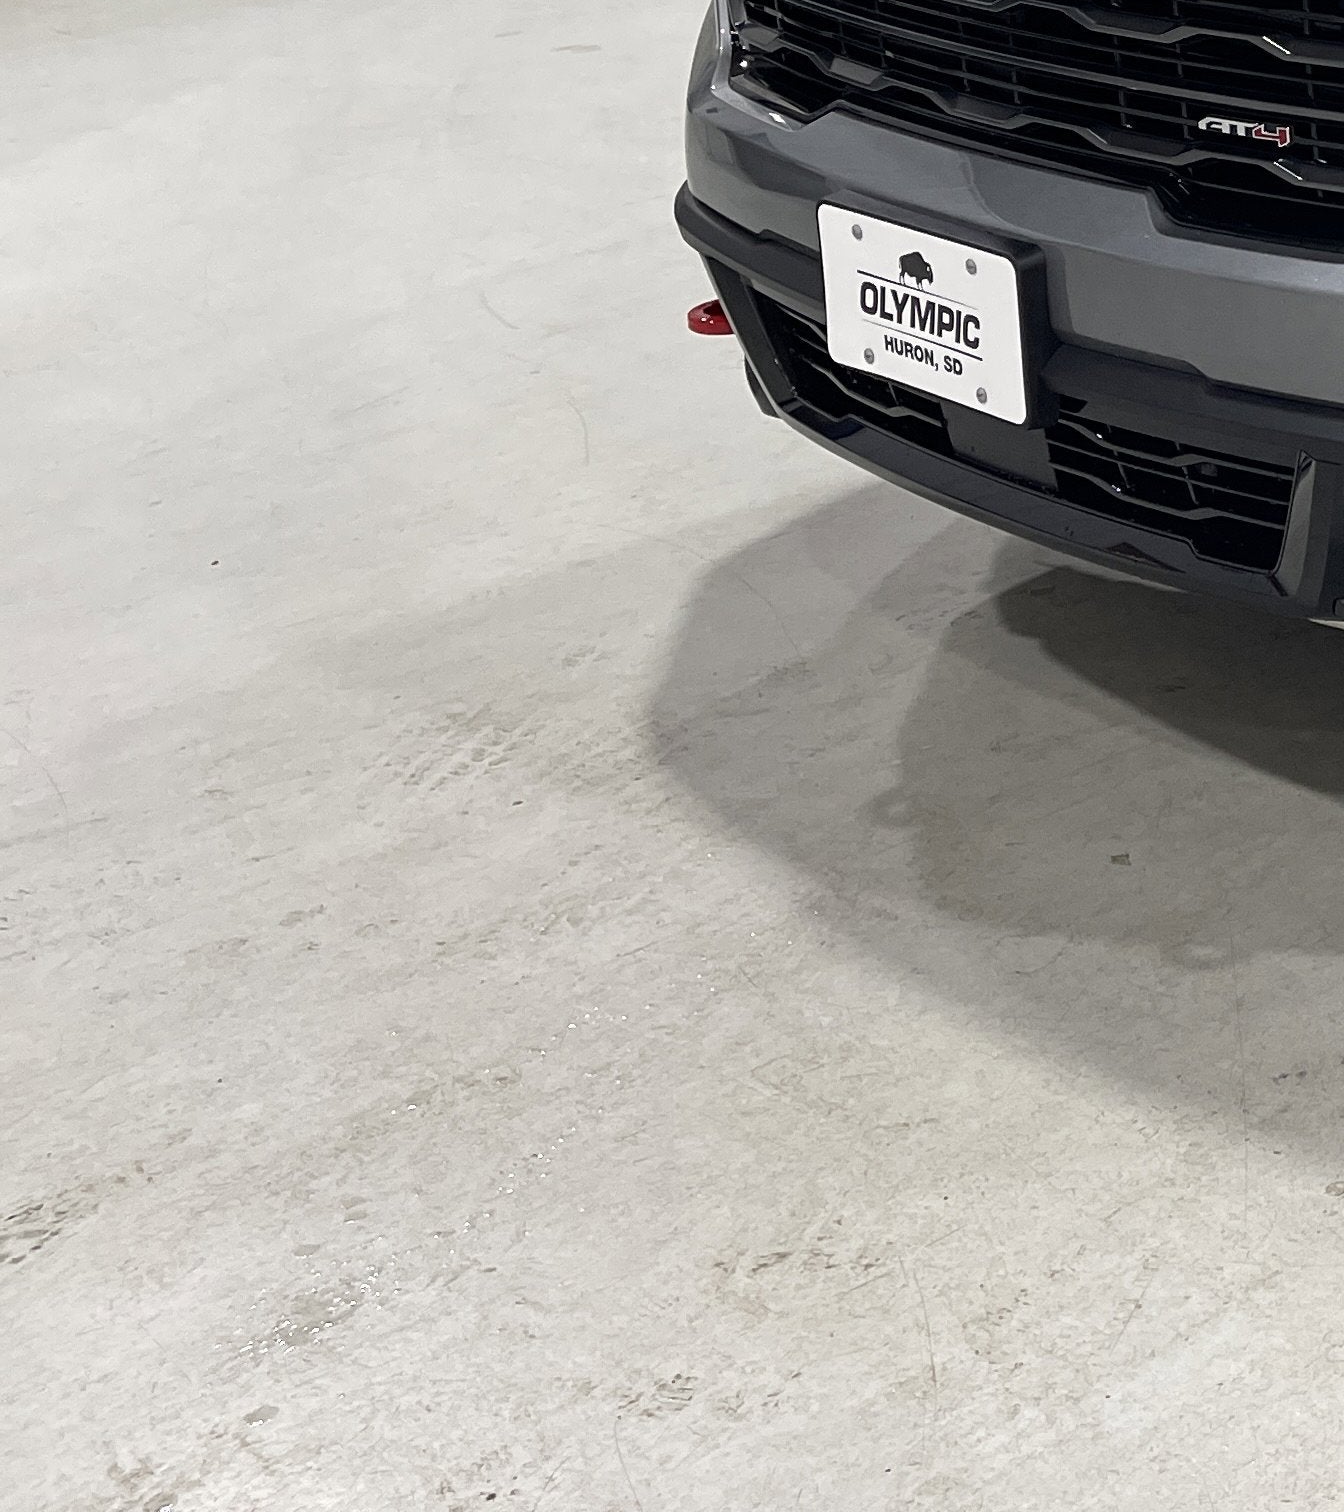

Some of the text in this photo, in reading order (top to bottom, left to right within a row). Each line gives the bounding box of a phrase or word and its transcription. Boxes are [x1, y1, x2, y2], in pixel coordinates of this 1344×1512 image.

[1198, 116, 1290, 148] AT4
[860, 281, 980, 350] OLYMPIC
[884, 335, 963, 376] HURON, SD
